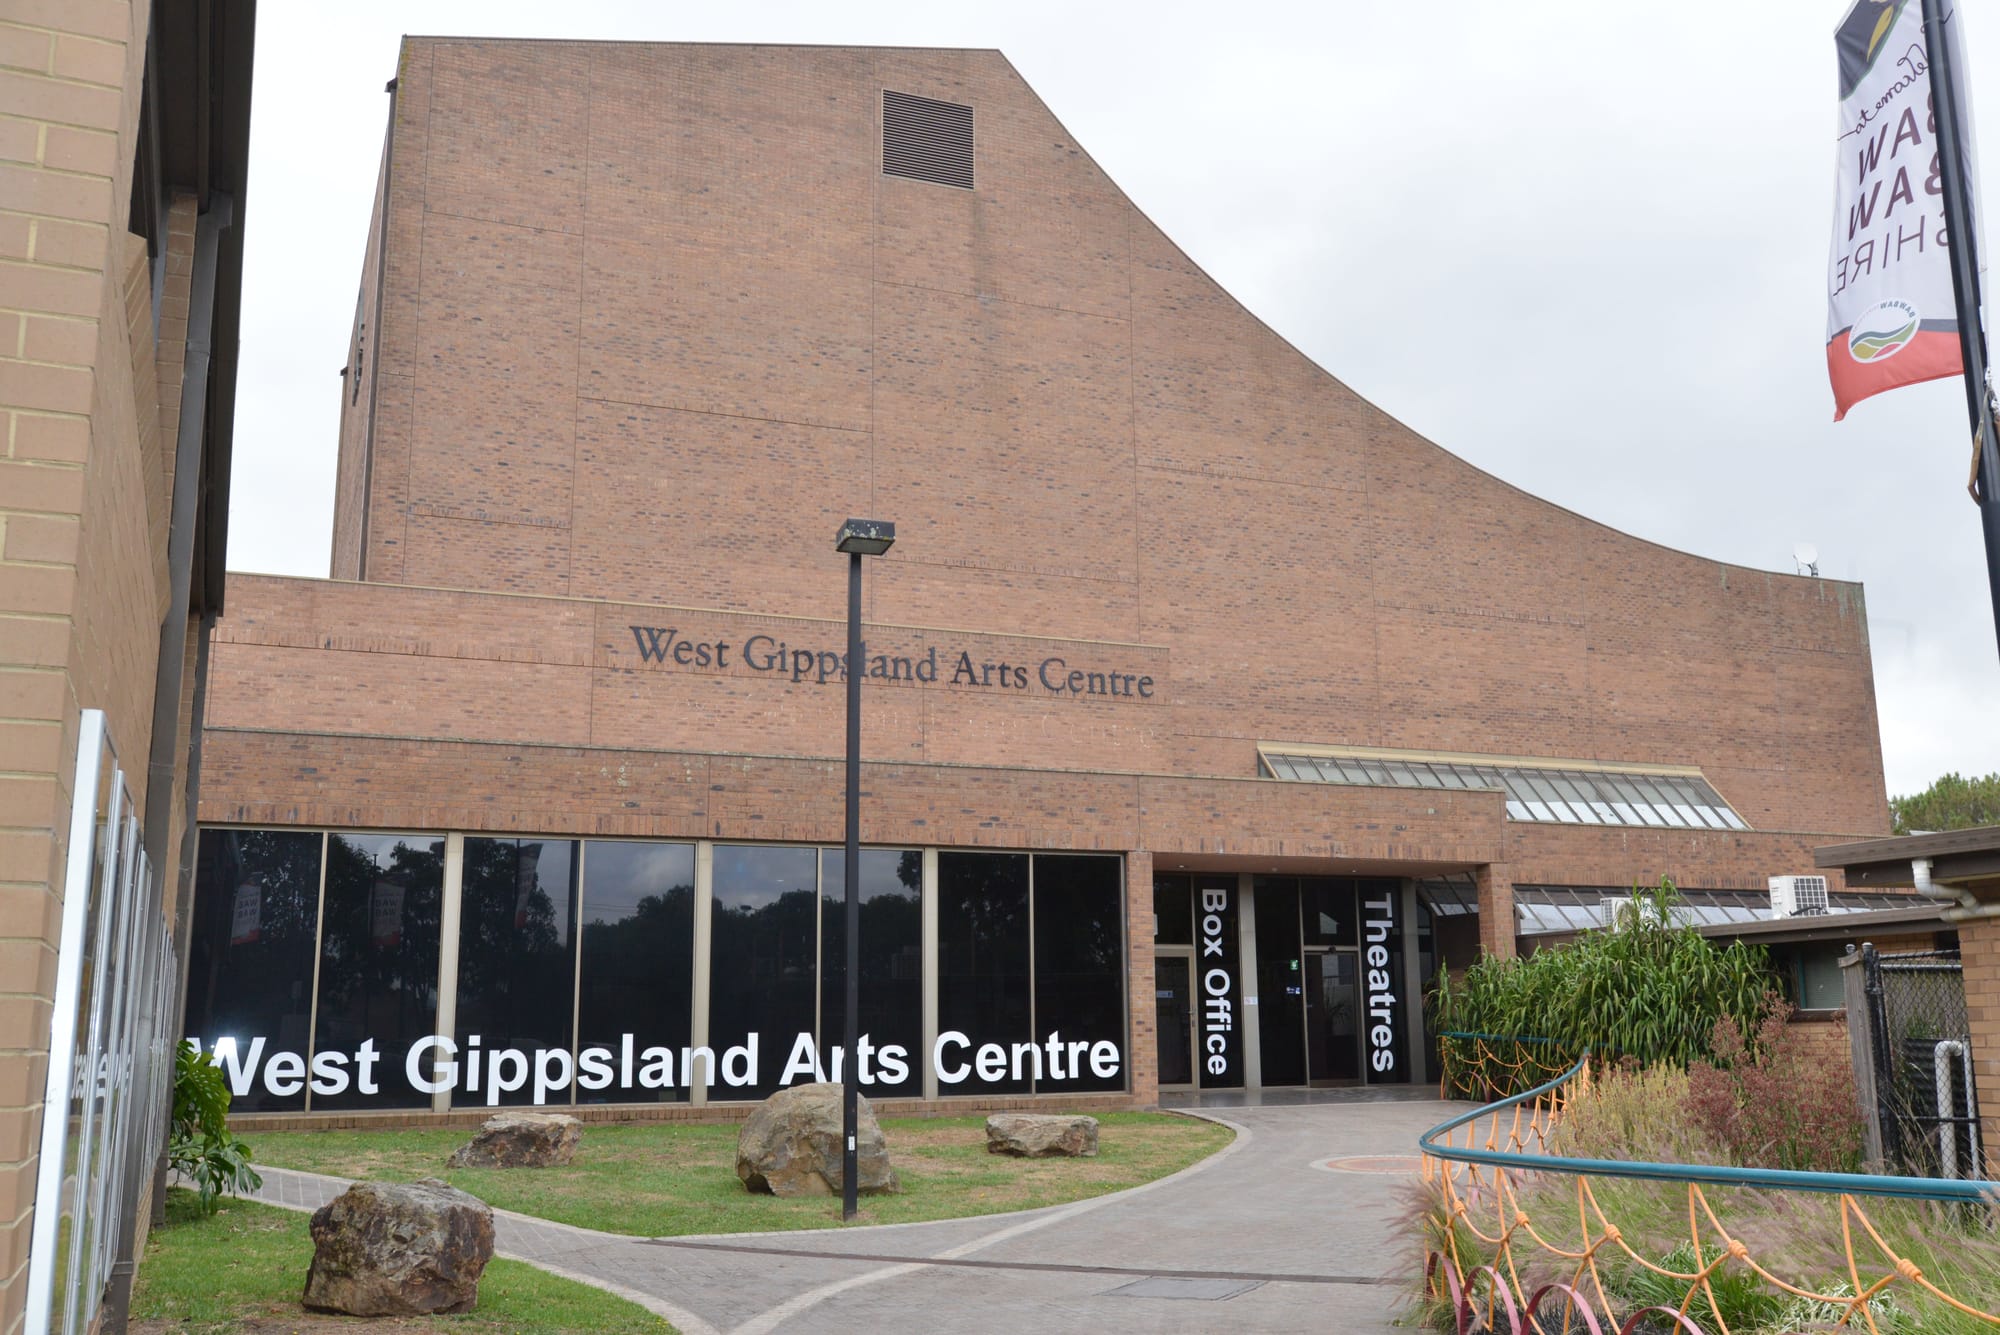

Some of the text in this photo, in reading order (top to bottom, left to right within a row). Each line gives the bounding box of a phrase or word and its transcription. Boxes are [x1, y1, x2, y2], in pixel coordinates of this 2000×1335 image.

[629, 626, 730, 669] West
[950, 649, 1029, 690] Arts
[1037, 657, 1155, 698] Centre
[1201, 888, 1233, 1076] Box Office
[1364, 892, 1397, 1073] Theatres
[185, 1035, 380, 1097] West
[405, 1031, 759, 1106] Gippsland
[778, 1031, 910, 1085] Arts
[932, 1029, 1121, 1085] Centre
